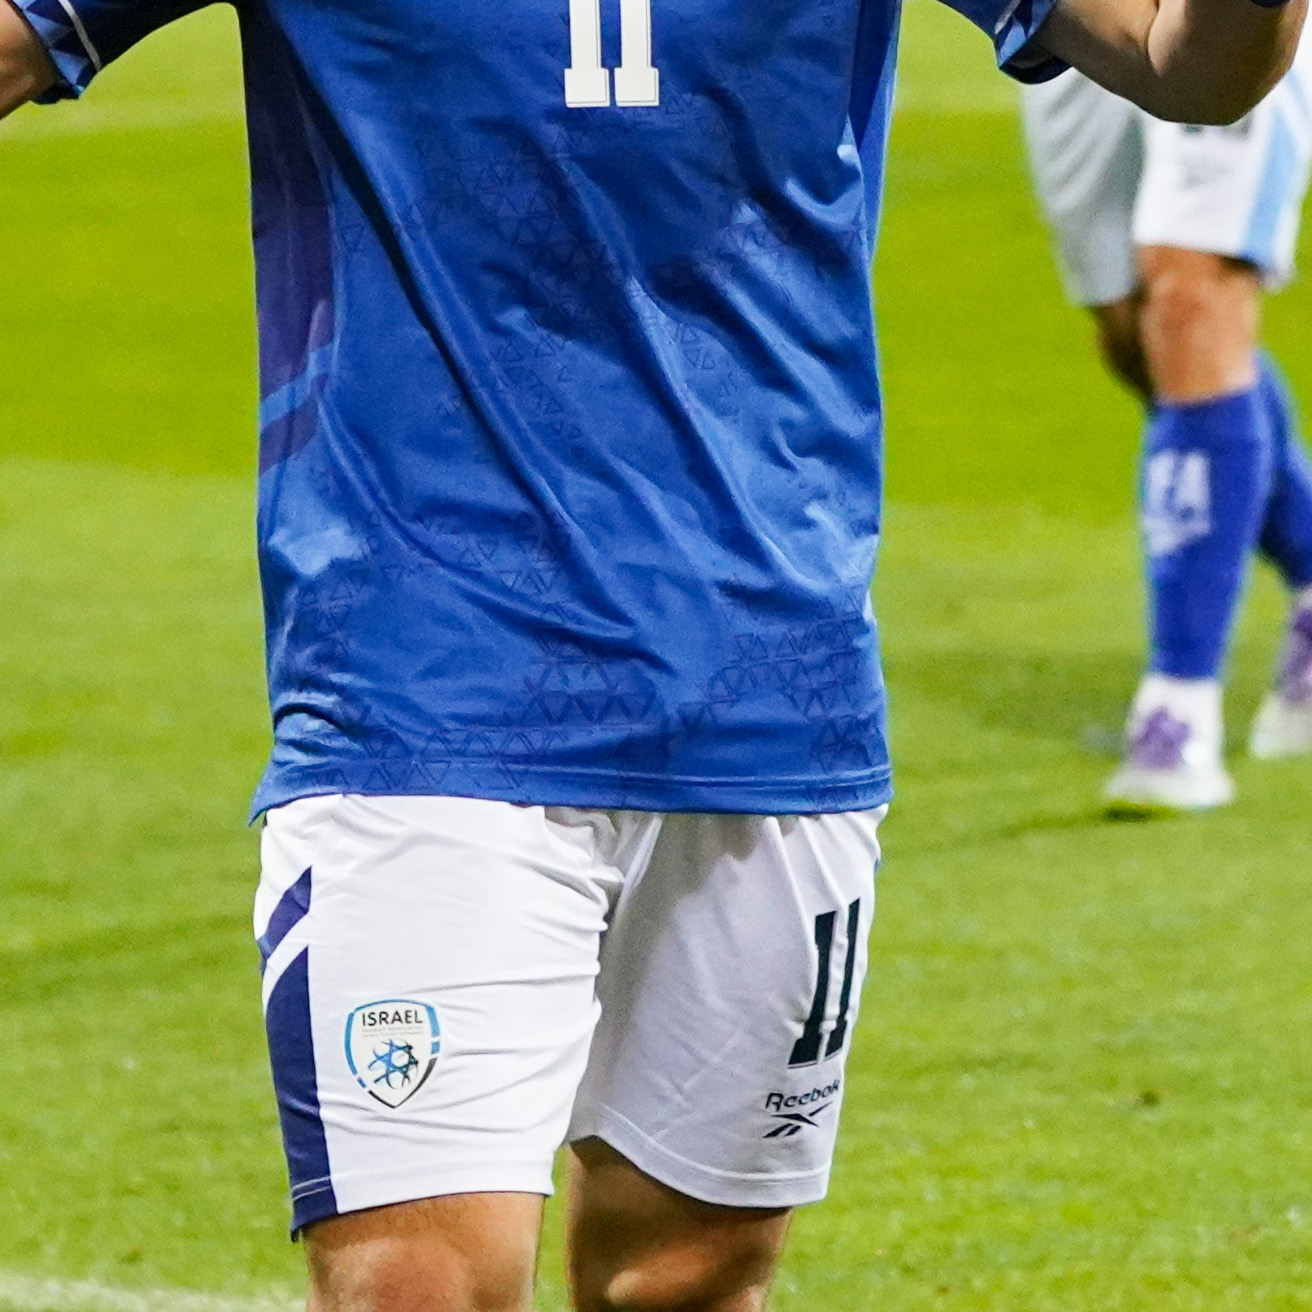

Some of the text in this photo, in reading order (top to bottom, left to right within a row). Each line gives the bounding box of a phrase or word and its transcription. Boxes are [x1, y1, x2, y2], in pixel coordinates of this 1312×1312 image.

[787, 897, 861, 1069] 11
[362, 1009, 423, 1027] ISRAEL
[765, 1079, 841, 1112] Reebok
